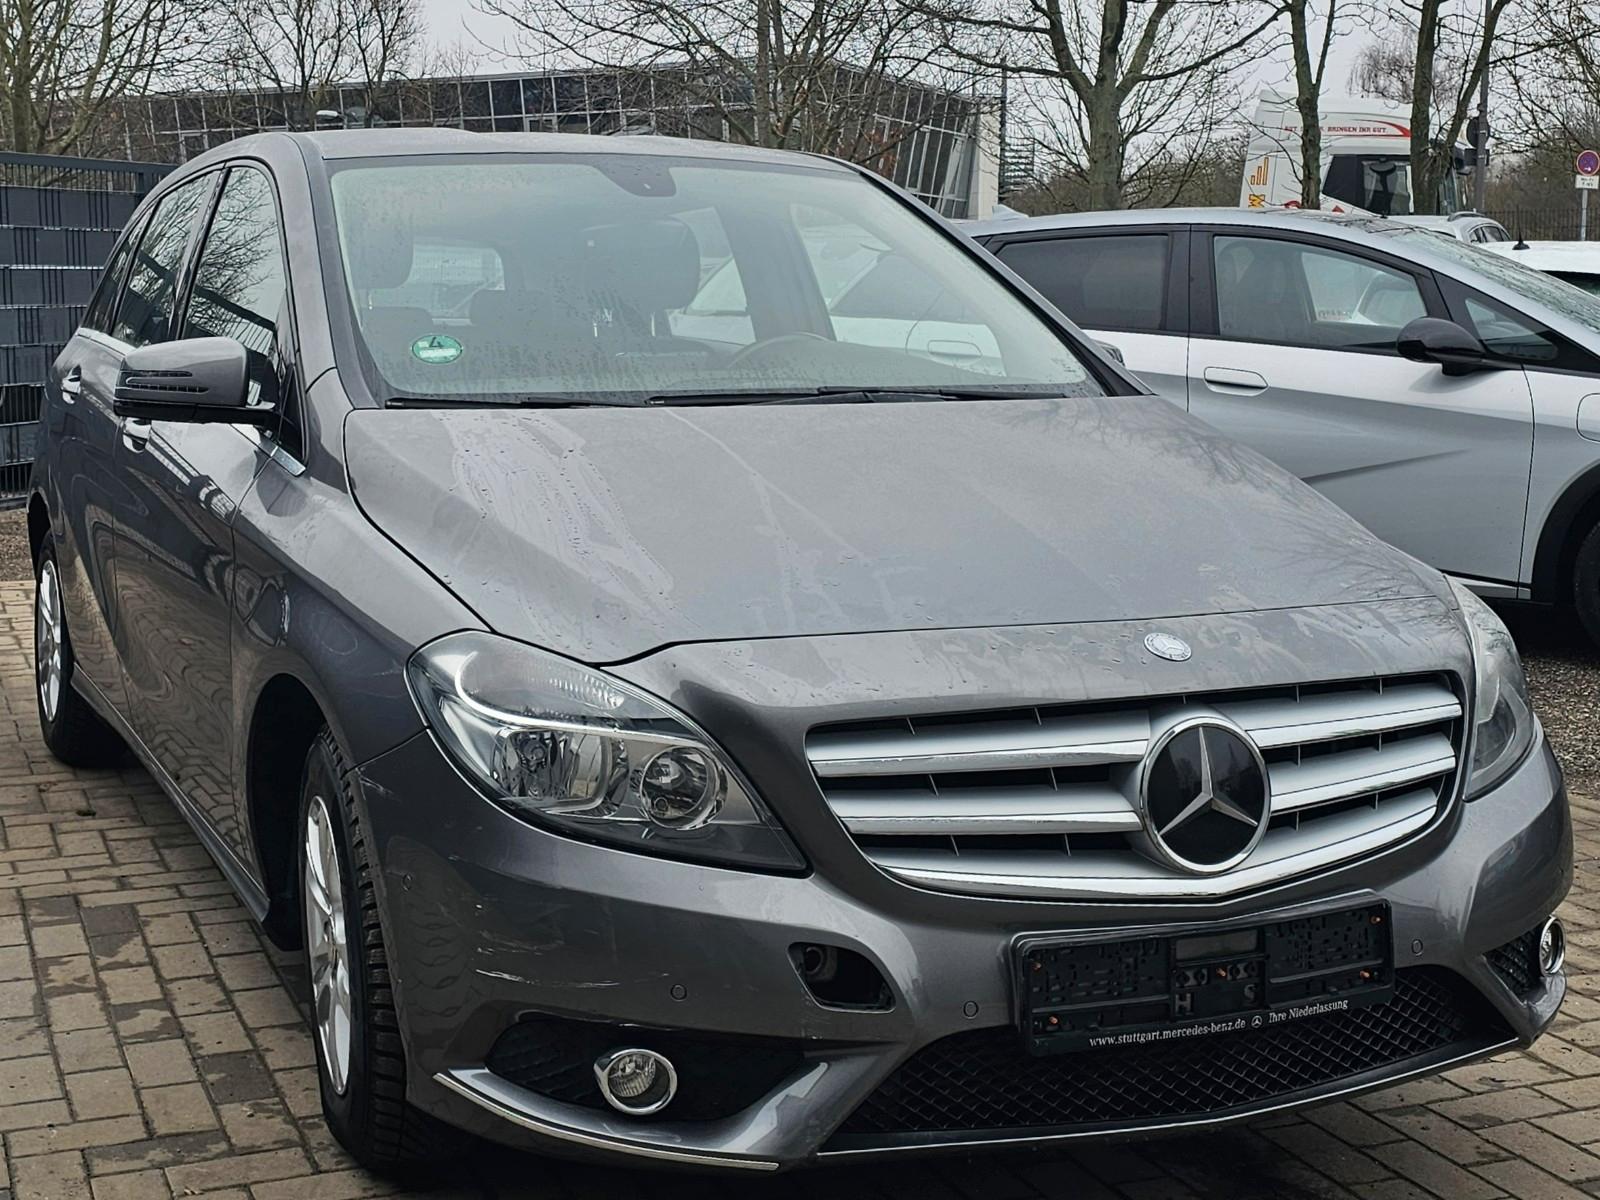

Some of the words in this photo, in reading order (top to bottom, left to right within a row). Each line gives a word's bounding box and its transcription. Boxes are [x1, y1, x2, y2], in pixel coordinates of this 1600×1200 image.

[428, 336, 444, 349] 4
[1089, 1018, 1246, 1047] www.stuttgart.mercedes-benz.de
[1268, 1012, 1287, 1023] Ihre
[1288, 999, 1349, 1019] Niederlassung
